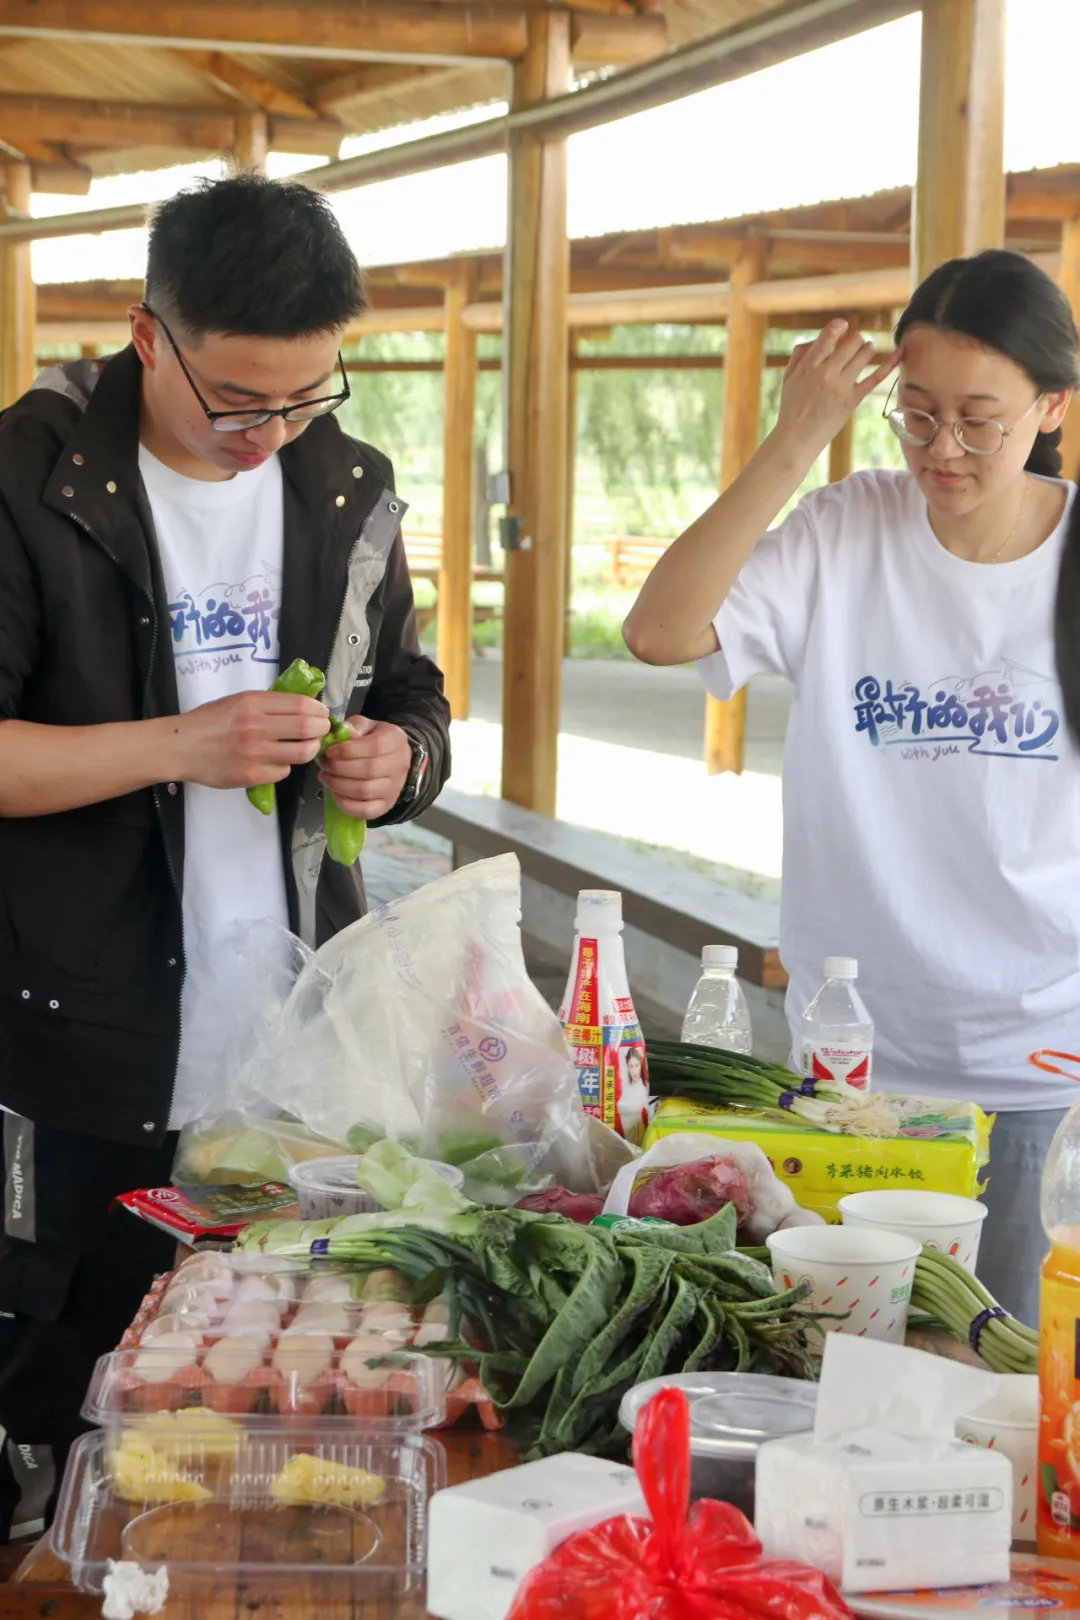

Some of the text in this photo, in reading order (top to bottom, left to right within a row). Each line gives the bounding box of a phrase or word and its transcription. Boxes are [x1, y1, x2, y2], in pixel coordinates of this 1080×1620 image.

[853, 675, 1060, 751] 最好的我们
[932, 744, 961, 762] you
[825, 1162, 925, 1181] 芹菜猪肉水饺
